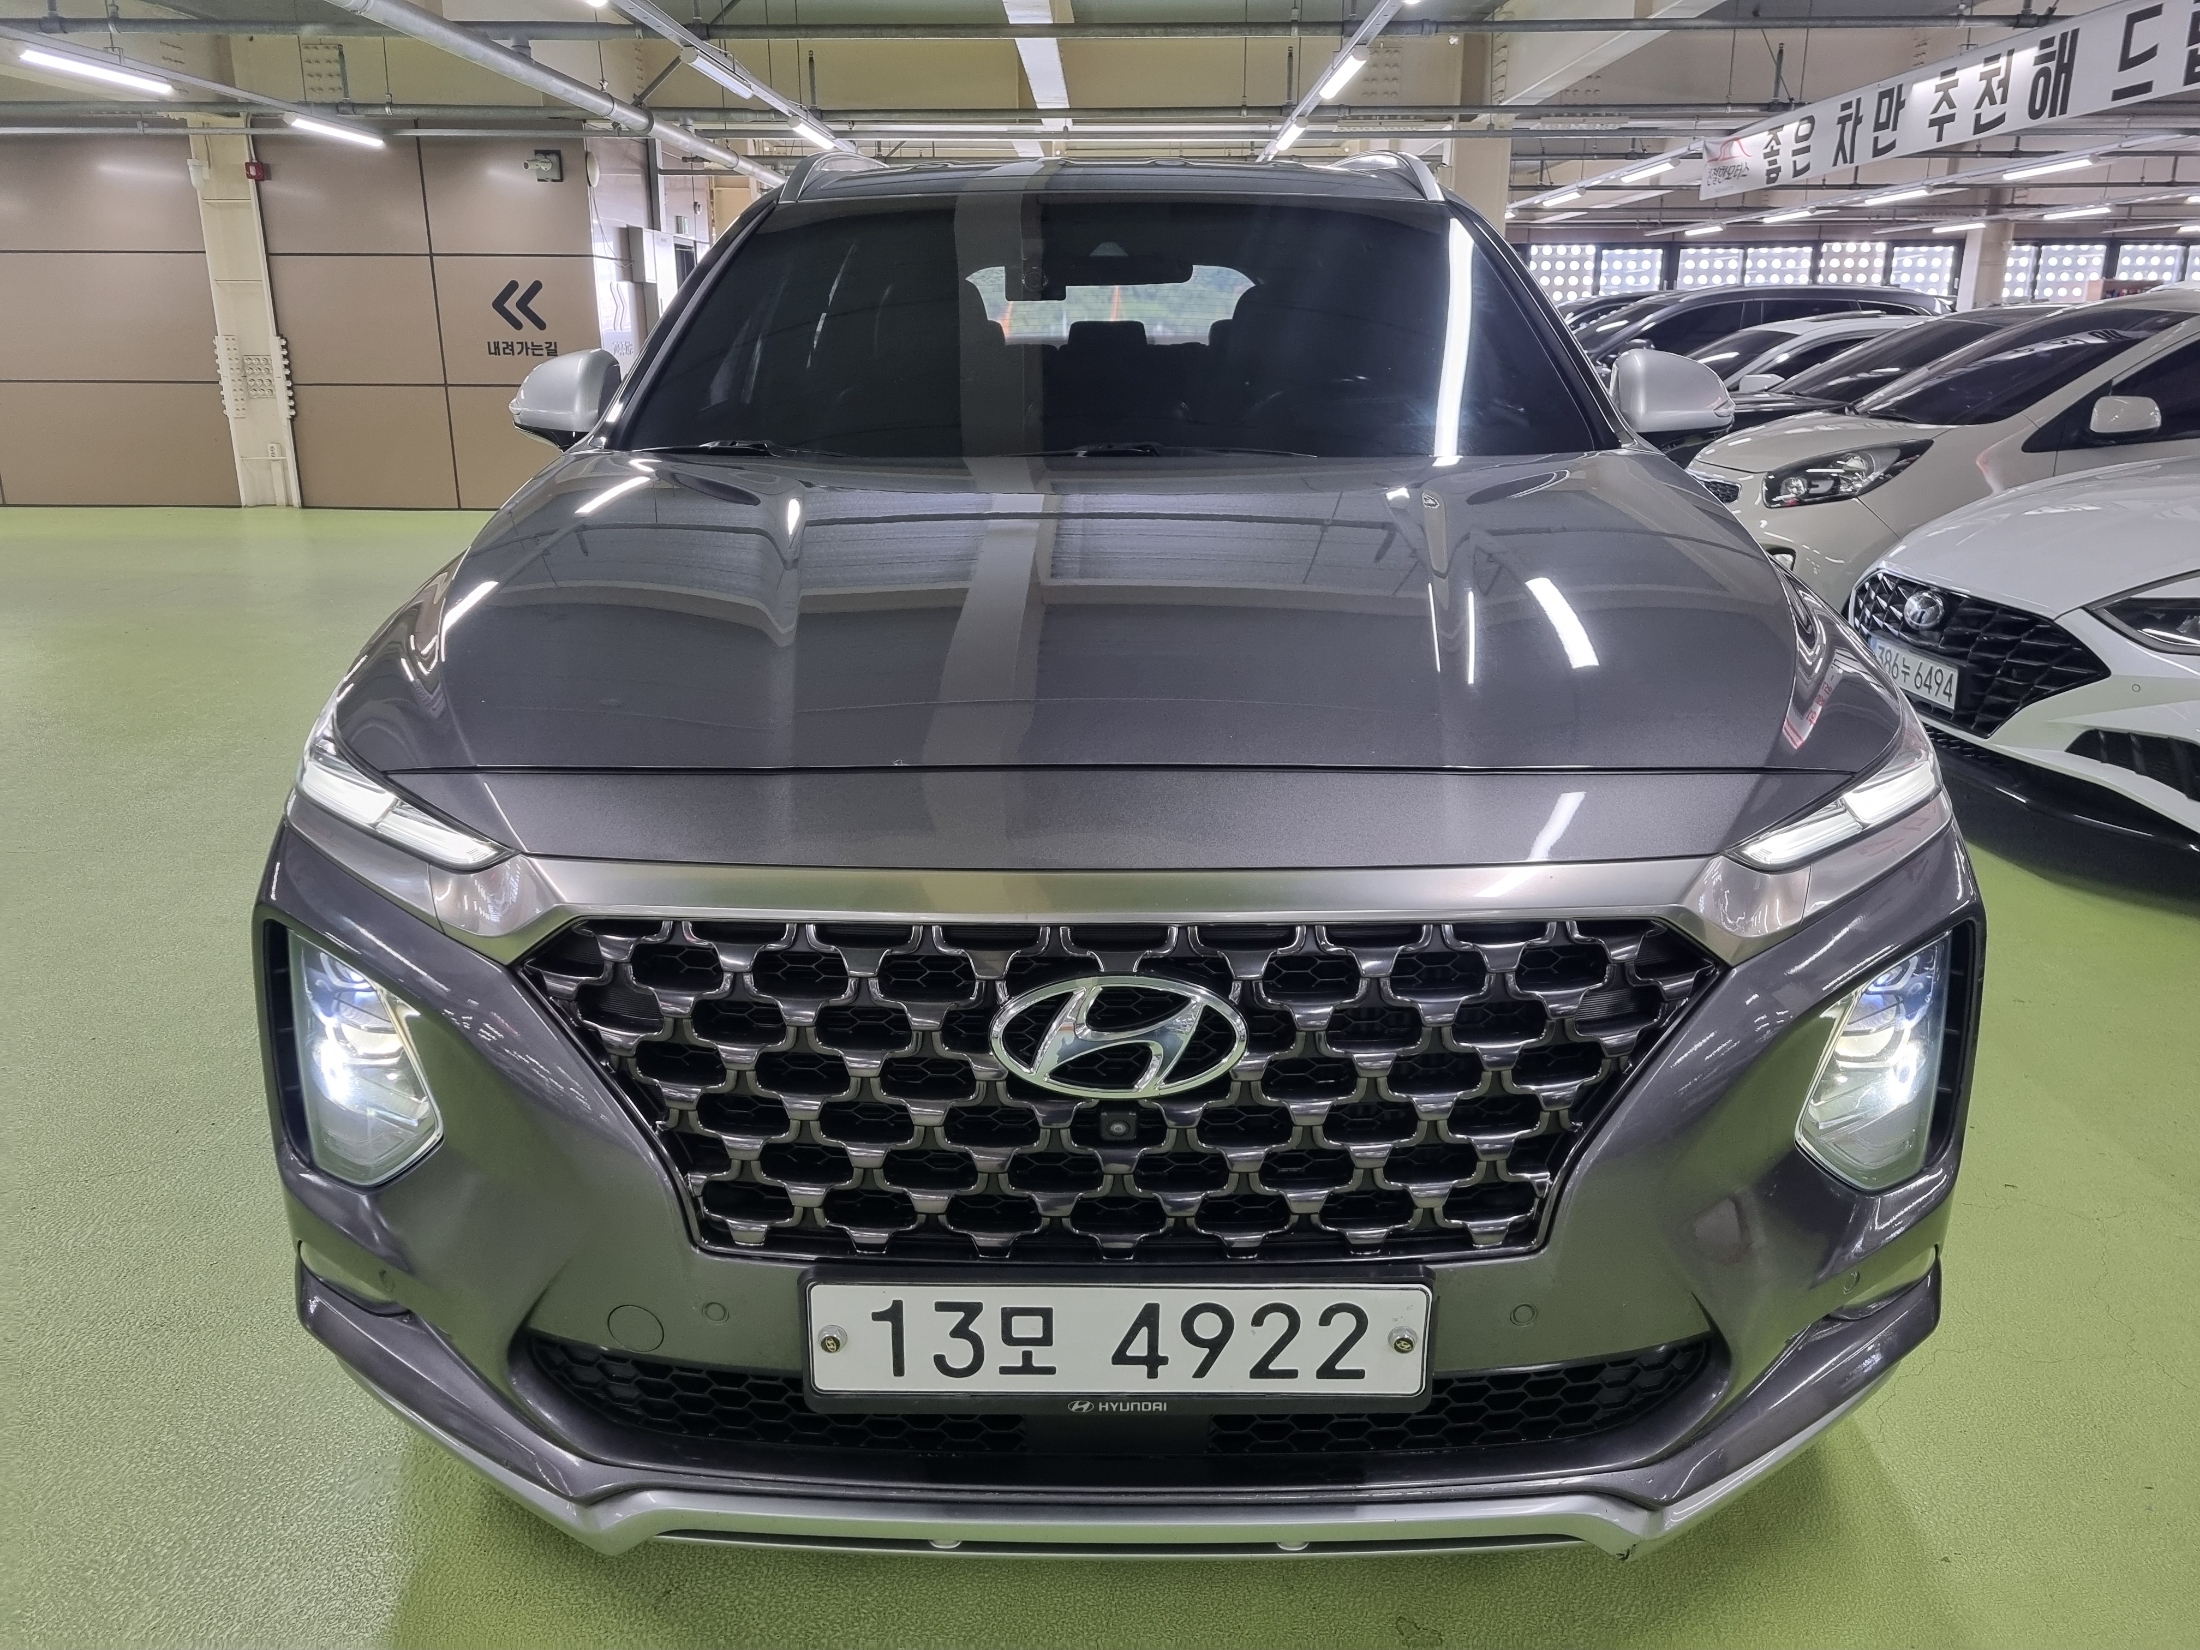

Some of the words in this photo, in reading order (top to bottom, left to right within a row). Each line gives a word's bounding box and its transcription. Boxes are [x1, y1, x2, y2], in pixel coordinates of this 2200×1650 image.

[1763, 114, 1816, 185] 좋은
[1832, 82, 1906, 168] 차만
[1928, 27, 2080, 143] 추천해
[2111, 0, 2200, 102] 드
[487, 341, 559, 357] 내려가는길
[1914, 661, 1954, 702] 6494
[871, 1299, 1058, 1379] 13모
[1111, 1302, 1370, 1380] 4922
[1098, 1401, 1167, 1412] HYUNDAI
